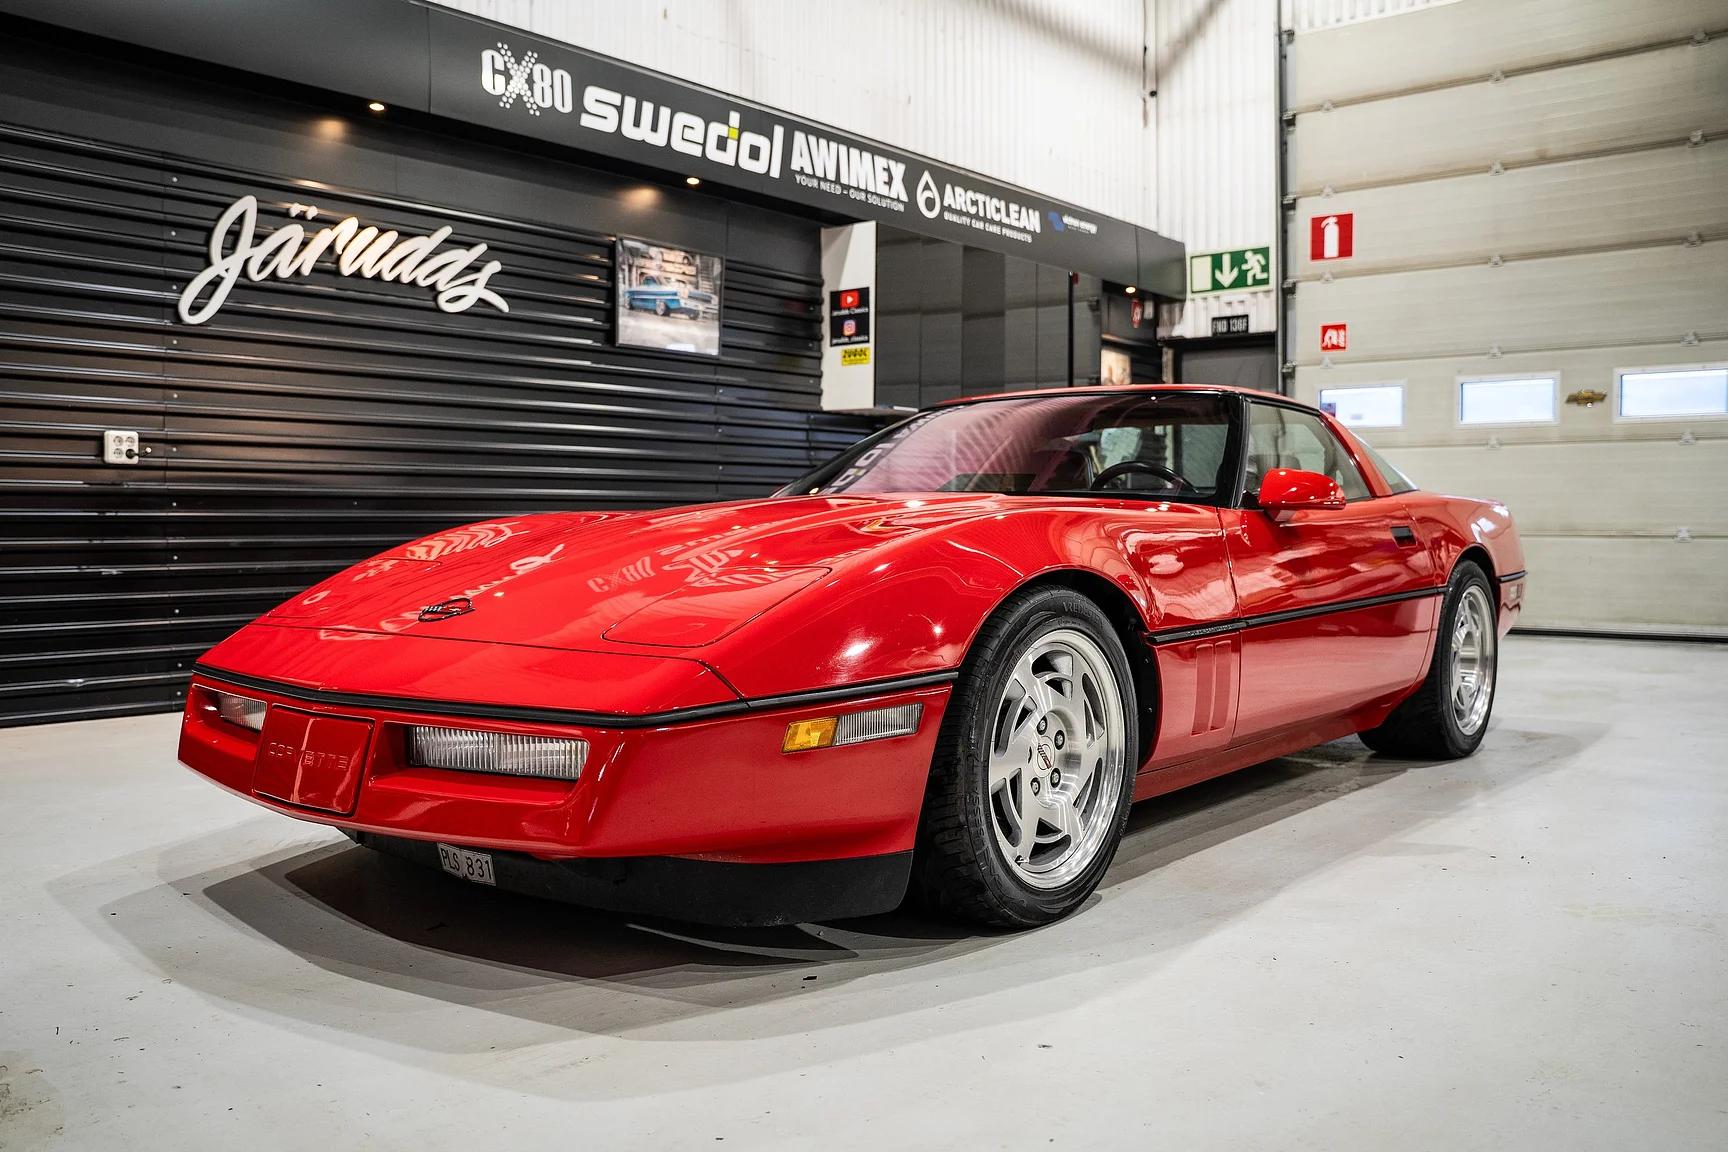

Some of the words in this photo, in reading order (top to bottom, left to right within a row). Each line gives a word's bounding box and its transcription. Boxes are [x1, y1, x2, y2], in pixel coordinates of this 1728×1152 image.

[481, 42, 573, 116] CX80
[580, 85, 784, 179] swedol
[790, 130, 909, 202] AWIMEX
[795, 173, 819, 189] YOUR
[820, 181, 842, 195] NEED
[849, 188, 867, 202] OUR
[867, 193, 905, 212] SOLUTION
[943, 183, 1041, 233] ARCTICLEAN
[943, 211, 971, 226] QUALITY
[268, 742, 348, 771] CORVETTE
[440, 848, 460, 872] PLS
[465, 856, 492, 880] 831
